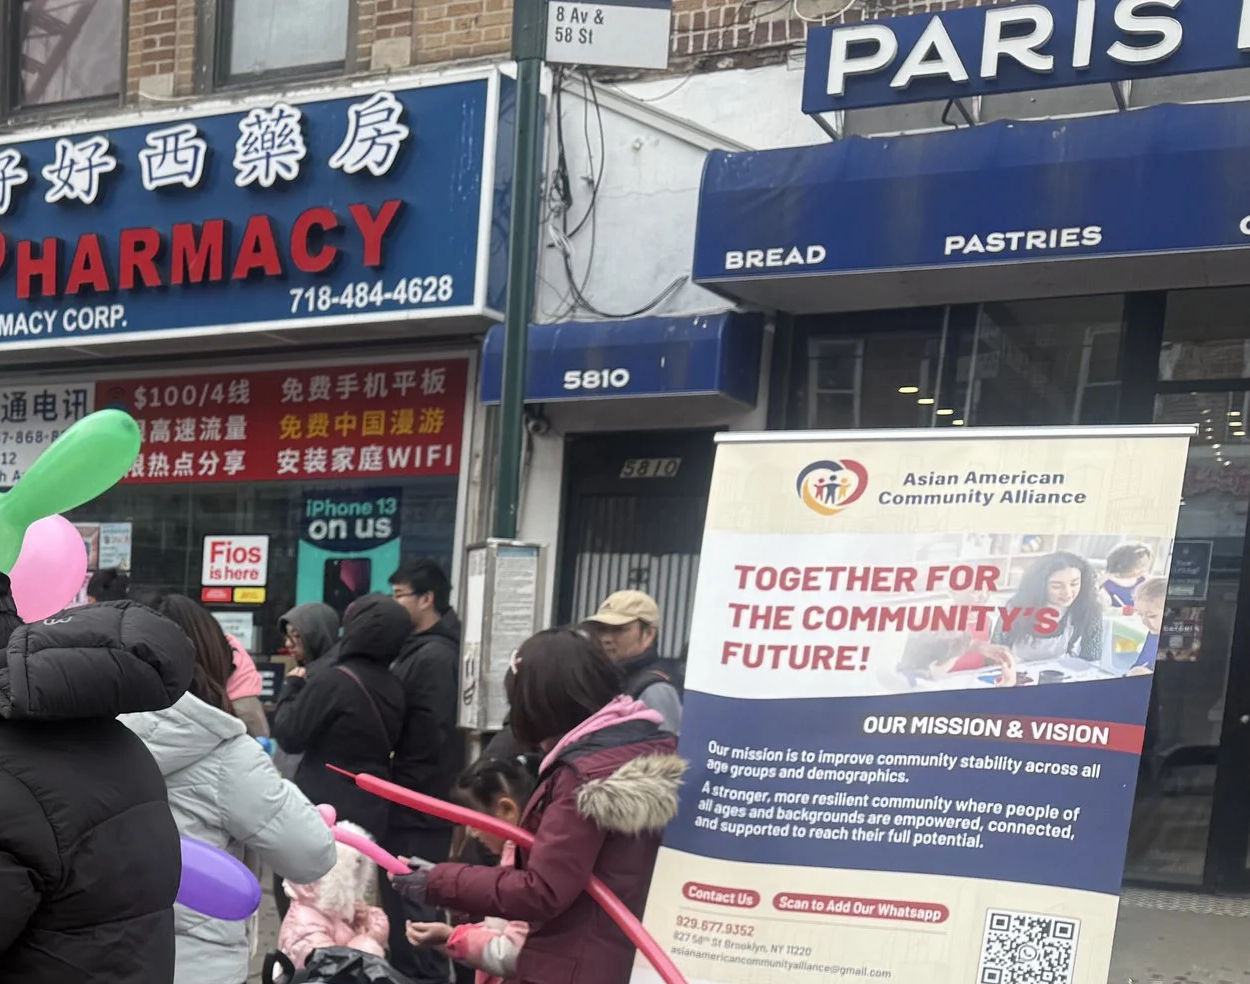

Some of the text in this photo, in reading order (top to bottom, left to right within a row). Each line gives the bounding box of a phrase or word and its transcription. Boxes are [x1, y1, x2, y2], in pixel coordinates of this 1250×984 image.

[557, 6, 604, 24] 8 Av &
[555, 27, 593, 44] 58 St
[826, 0, 1183, 96] PARIS
[725, 225, 1103, 270] BREAD PASTRIES
[289, 275, 452, 314] 718-484-4628
[62, 305, 127, 331] CORP.
[281, 368, 446, 403] 免费手机平板
[562, 368, 630, 389] 5810
[134, 379, 251, 409] $100/4线
[279, 408, 445, 440] 免费中国漫游
[277, 444, 453, 475] 安装家庭WIFI
[623, 460, 678, 476] 5810
[902, 471, 1065, 487] Asian American
[306, 497, 397, 517] iPhone 13
[878, 489, 1087, 507] Community Alliance
[308, 517, 391, 540] on us
[210, 541, 261, 563] Fios
[210, 566, 259, 580] is here
[734, 564, 1002, 592] TOGETHER FOR
[728, 603, 794, 631] THE
[720, 641, 870, 671] FUTURE!
[863, 715, 1110, 745] OUR MISSION VISION
[708, 740, 1101, 778] Our mission improve community stability across all
[731, 763, 909, 785] groups and demographics.
[774, 790, 1060, 821] more resilient community where people
[720, 818, 985, 849] supported reach their full potential.
[776, 805, 1075, 840] backgrounds empowered, connected,
[688, 886, 753, 906] Contact Us
[779, 896, 942, 922] Scan Add Our Whatsapp
[676, 915, 755, 937] 929.677.9352
[724, 938, 812, 957] Brooklyn, 11220
